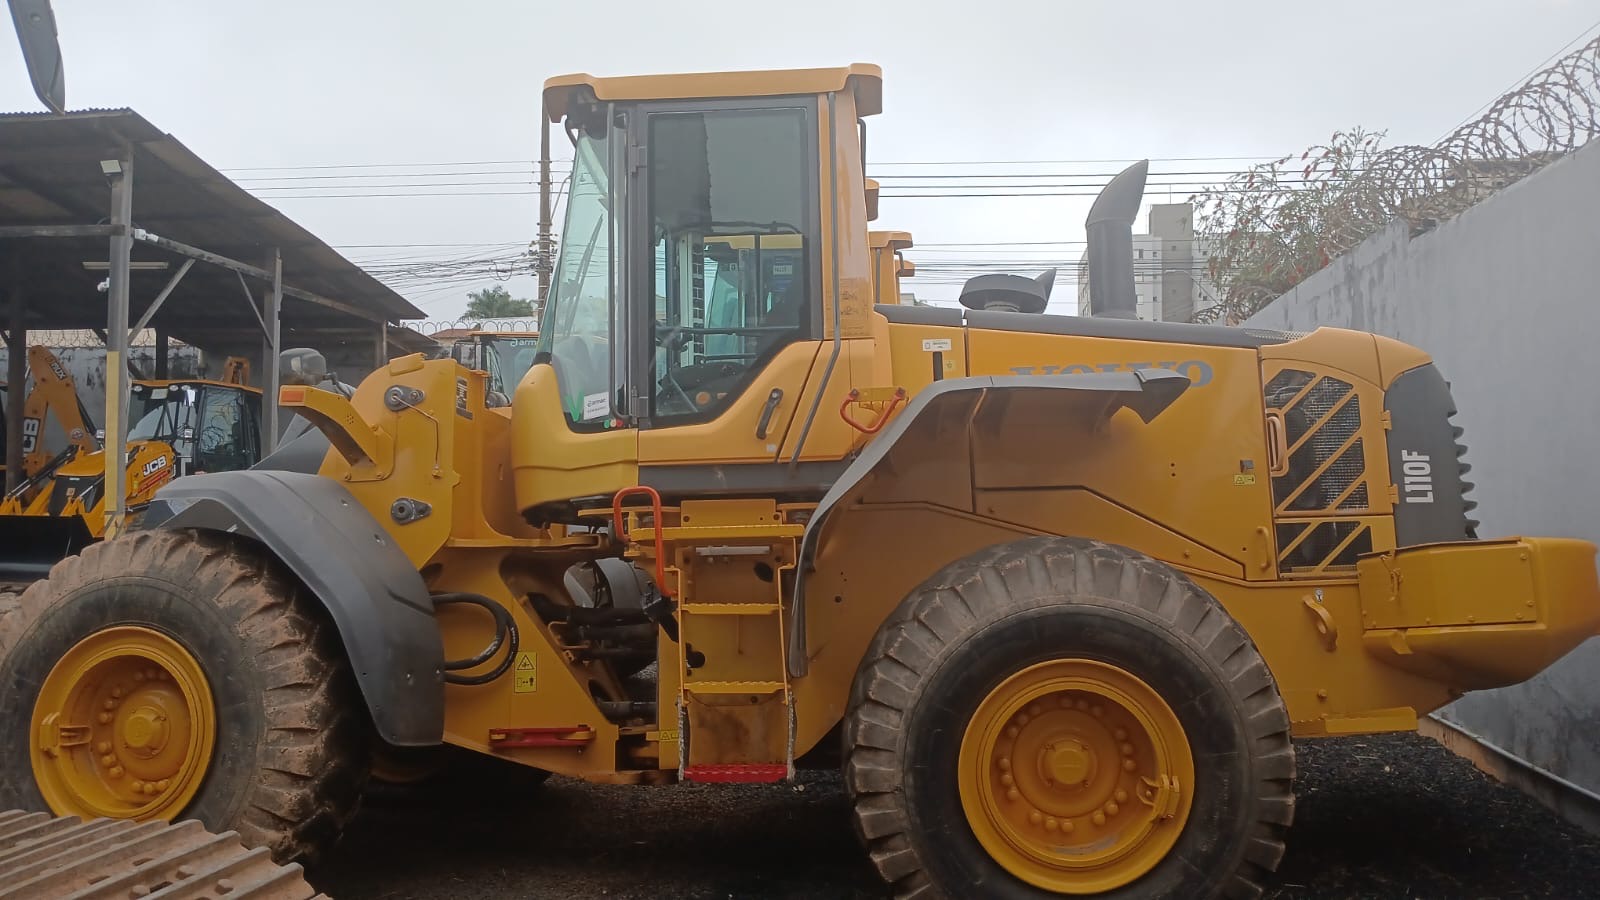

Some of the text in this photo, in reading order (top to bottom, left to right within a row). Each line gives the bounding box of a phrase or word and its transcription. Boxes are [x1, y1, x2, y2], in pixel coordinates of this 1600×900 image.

[24, 418, 40, 456] CB
[143, 455, 167, 476] JCB
[1402, 449, 1434, 503] L110F
